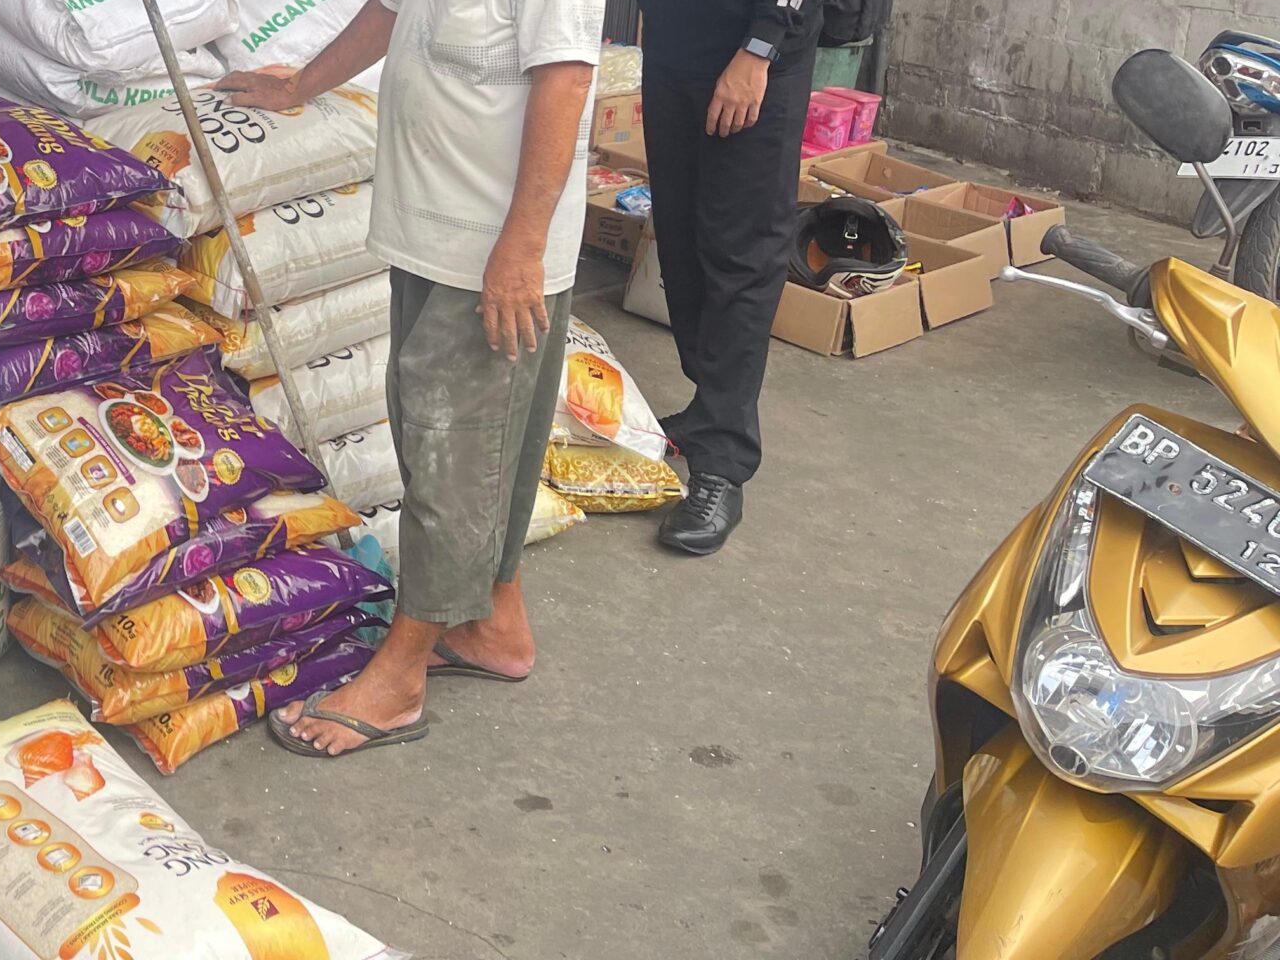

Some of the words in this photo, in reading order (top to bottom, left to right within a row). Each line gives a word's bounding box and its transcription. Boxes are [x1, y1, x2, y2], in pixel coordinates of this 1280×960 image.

[161, 100, 240, 154] GOG
[196, 92, 267, 144] GONG
[1119, 423, 1180, 465] BP
[164, 851, 230, 878] ONG
